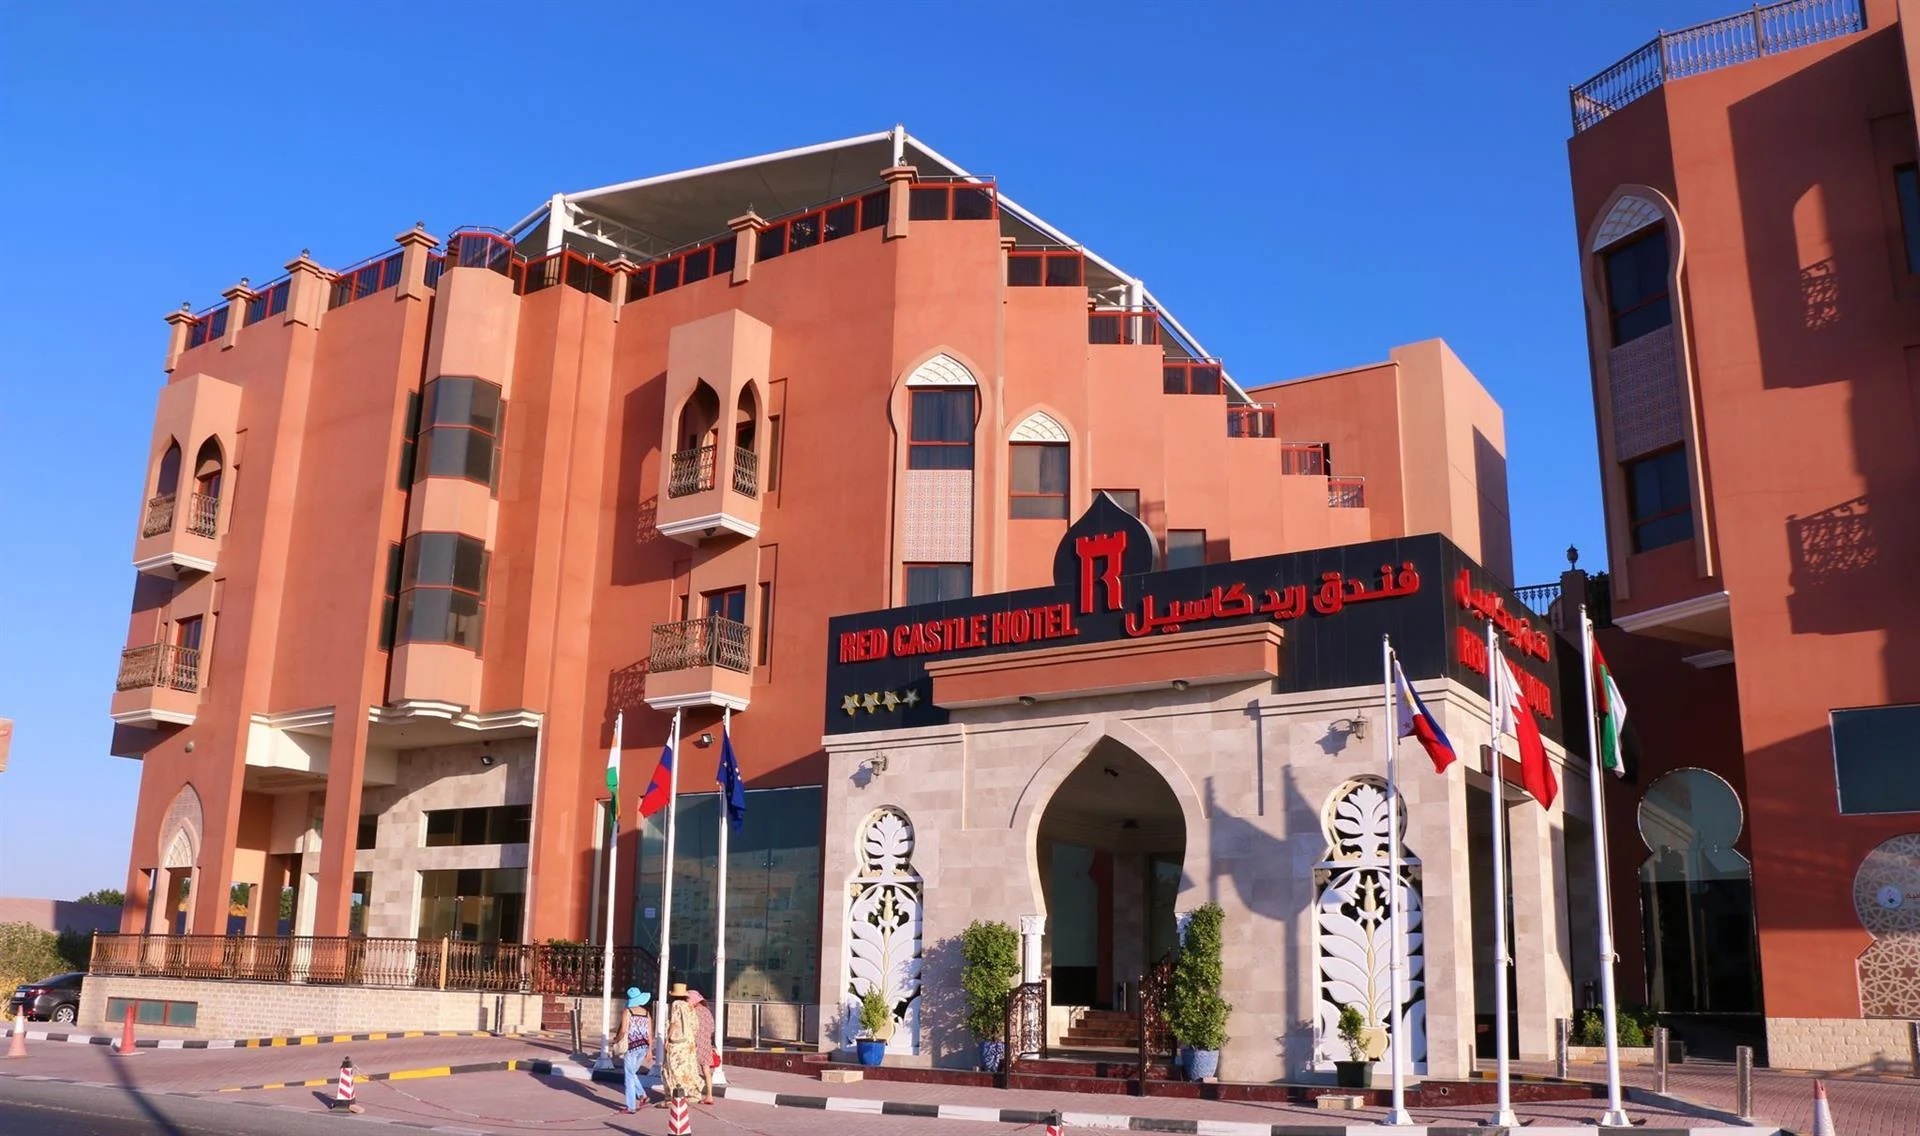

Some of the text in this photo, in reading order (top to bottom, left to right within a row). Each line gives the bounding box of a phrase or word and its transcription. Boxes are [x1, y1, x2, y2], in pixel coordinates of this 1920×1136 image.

[1124, 560, 1421, 637] فندق ريد كاسيل
[839, 603, 1080, 664] RED CASTLE HOTEL
